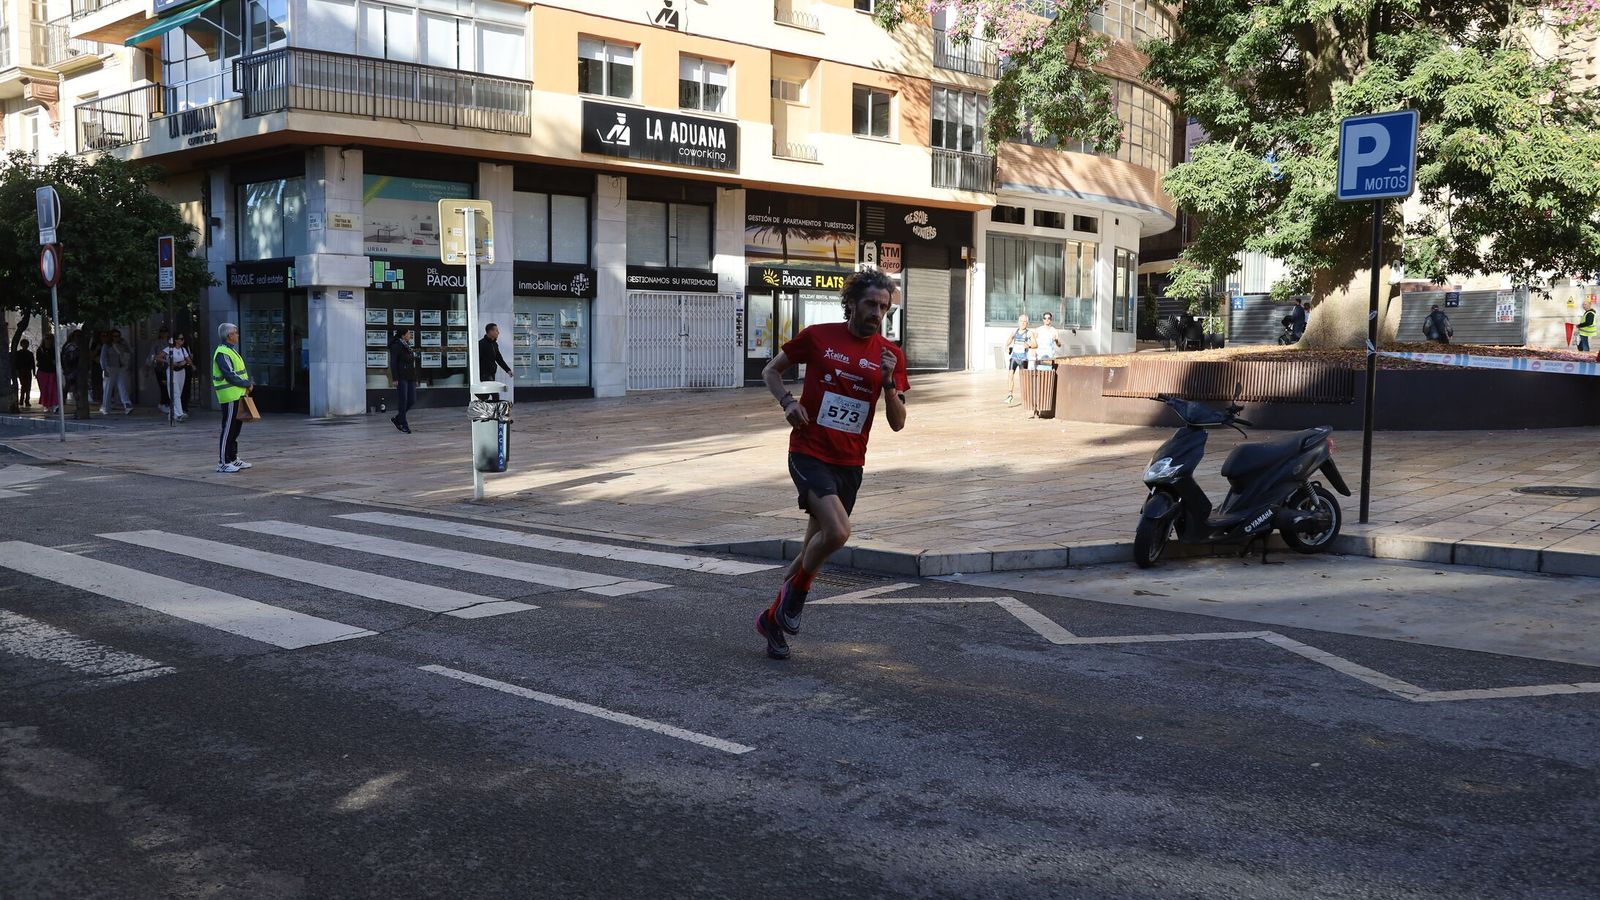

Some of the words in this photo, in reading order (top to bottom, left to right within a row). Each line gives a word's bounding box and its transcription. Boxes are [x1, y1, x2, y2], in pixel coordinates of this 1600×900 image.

[168, 115, 180, 139] LA
[181, 106, 217, 136] ADUANA
[646, 117, 663, 141] LA
[670, 121, 726, 149] ADUANA
[679, 146, 726, 162] coworking
[1343, 122, 1391, 190] P
[1365, 175, 1407, 191] MOTOS
[747, 214, 772, 223] GESTIÓN
[783, 217, 821, 227] APARTAMENTOS
[824, 221, 855, 230] TURÍSTICOS
[230, 272, 255, 285] PARQUE
[256, 273, 267, 285] real
[267, 273, 284, 284] estate
[427, 275, 467, 288] PARQU
[518, 280, 567, 292] inmobiliaria
[627, 275, 670, 285] GESTIONAMOS
[672, 277, 681, 285] SU
[681, 277, 716, 287] PATRIMONIO
[782, 275, 812, 287] PARQUE
[815, 275, 844, 288] FLATS
[827, 406, 860, 424] 573
[1250, 508, 1273, 528] YAMAHA
